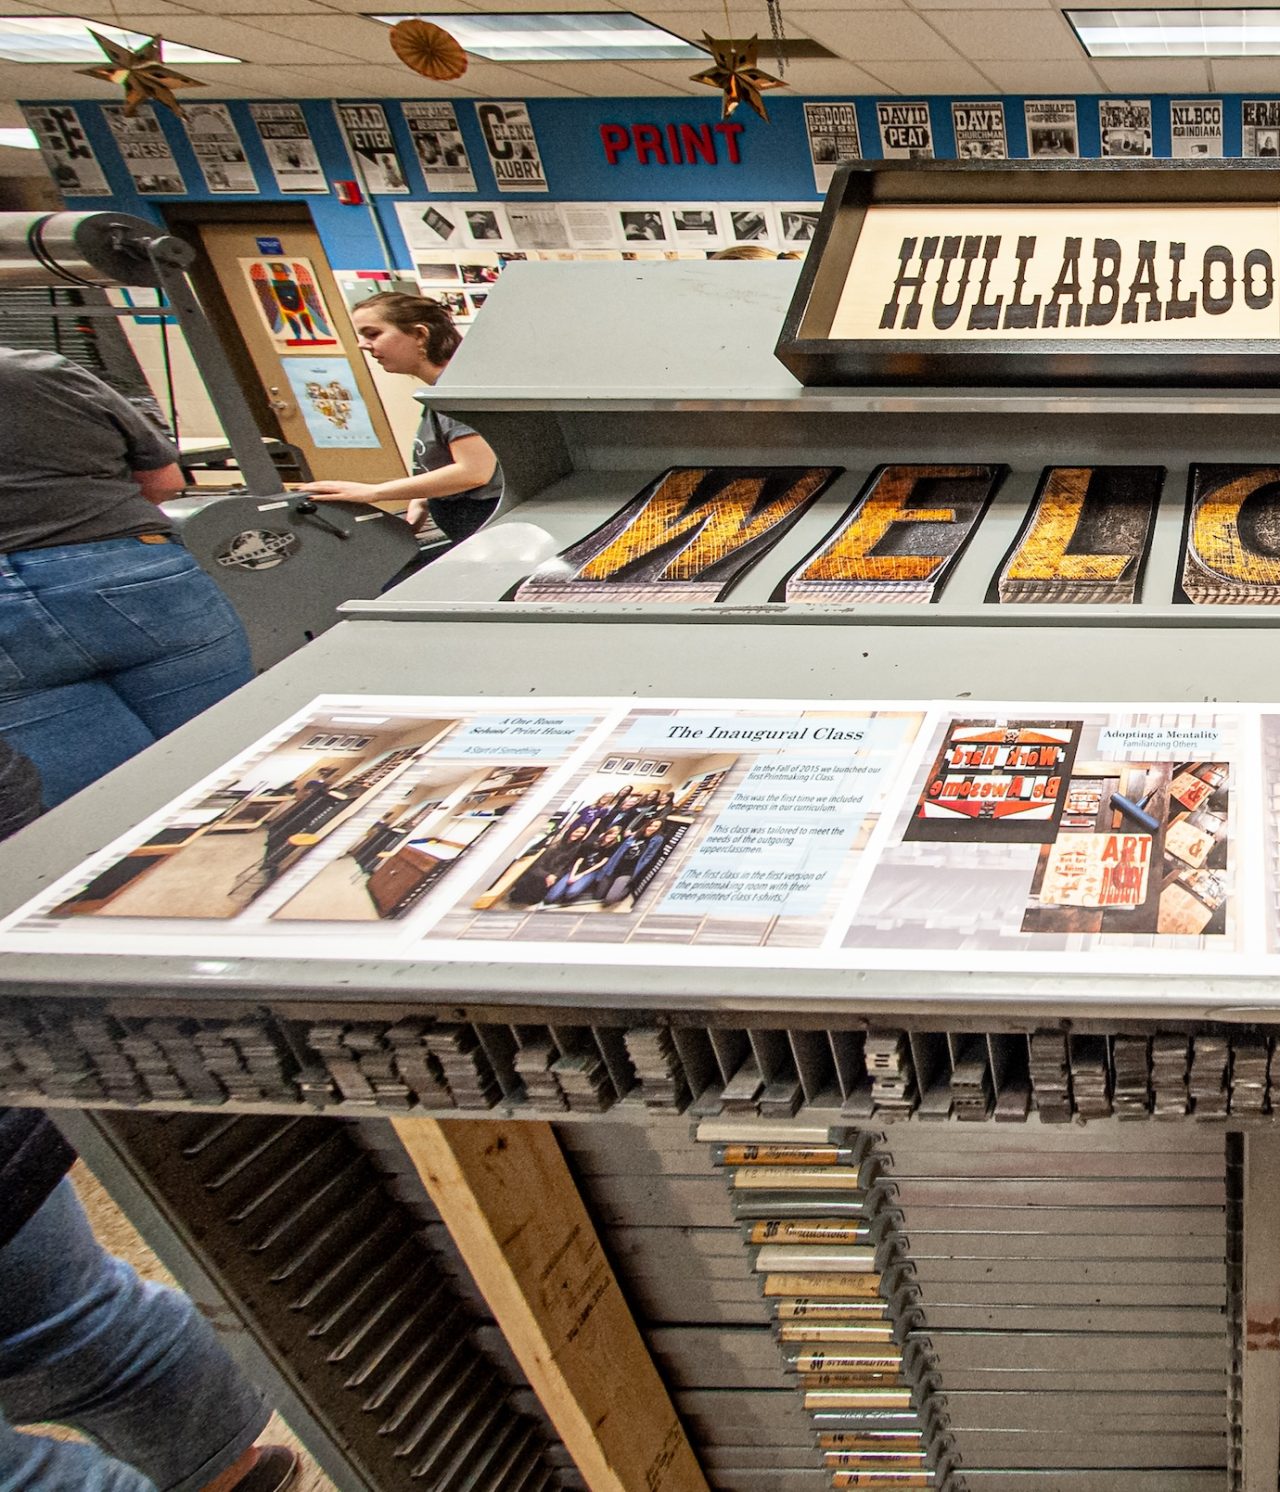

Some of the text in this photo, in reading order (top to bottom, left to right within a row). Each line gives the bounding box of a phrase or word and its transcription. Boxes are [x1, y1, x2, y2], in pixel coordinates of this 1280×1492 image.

[809, 115, 826, 125] RED
[825, 106, 855, 126] DOOR
[879, 108, 929, 125] DAVID
[955, 110, 1003, 131] DAVE
[1172, 107, 1221, 125] NLBCO
[811, 126, 856, 134] PRESS
[957, 131, 1004, 140] CHURCHMAN
[1186, 126, 1221, 137] INDIANA
[889, 127, 925, 147] PEAT
[119, 142, 171, 158] PRESS
[599, 123, 745, 165] PRINT
[495, 161, 542, 179] AUBRY
[878, 235, 1276, 331] HULLABALOO
[534, 717, 564, 726] Room
[469, 727, 575, 735] School Print House
[666, 726, 865, 742] The Inaugural Class
[1103, 730, 1155, 739] Adopting
[1166, 730, 1219, 740] Mentality
[1123, 739, 1198, 749] Familiarizing Others
[801, 765, 820, 773] 2015
[833, 765, 867, 774] launched
[747, 773, 763, 781] first
[763, 773, 810, 783] Printmaking
[734, 793, 750, 802] This
[765, 794, 780, 802] the
[780, 794, 797, 802] first
[797, 794, 814, 803] time
[814, 795, 827, 803] we
[827, 794, 864, 804] included
[728, 802, 768, 812] letterpress
[769, 803, 778, 811] in
[778, 804, 793, 812] our
[713, 824, 729, 833] This
[729, 825, 748, 834] class
[766, 825, 798, 835] tailored
[798, 827, 808, 835] to
[808, 827, 831, 836] meet
[831, 827, 845, 836] the
[706, 835, 795, 847] needs of the outgoing
[1101, 836, 1152, 862] ART
[701, 869, 719, 880] first
[719, 870, 738, 880] class
[741, 870, 750, 879] in
[751, 870, 766, 880] the
[766, 870, 783, 880] first
[783, 871, 814, 881] version
[815, 871, 828, 881] of
[675, 880, 811, 892] the printmaking room with their
[730, 892, 751, 902] class
